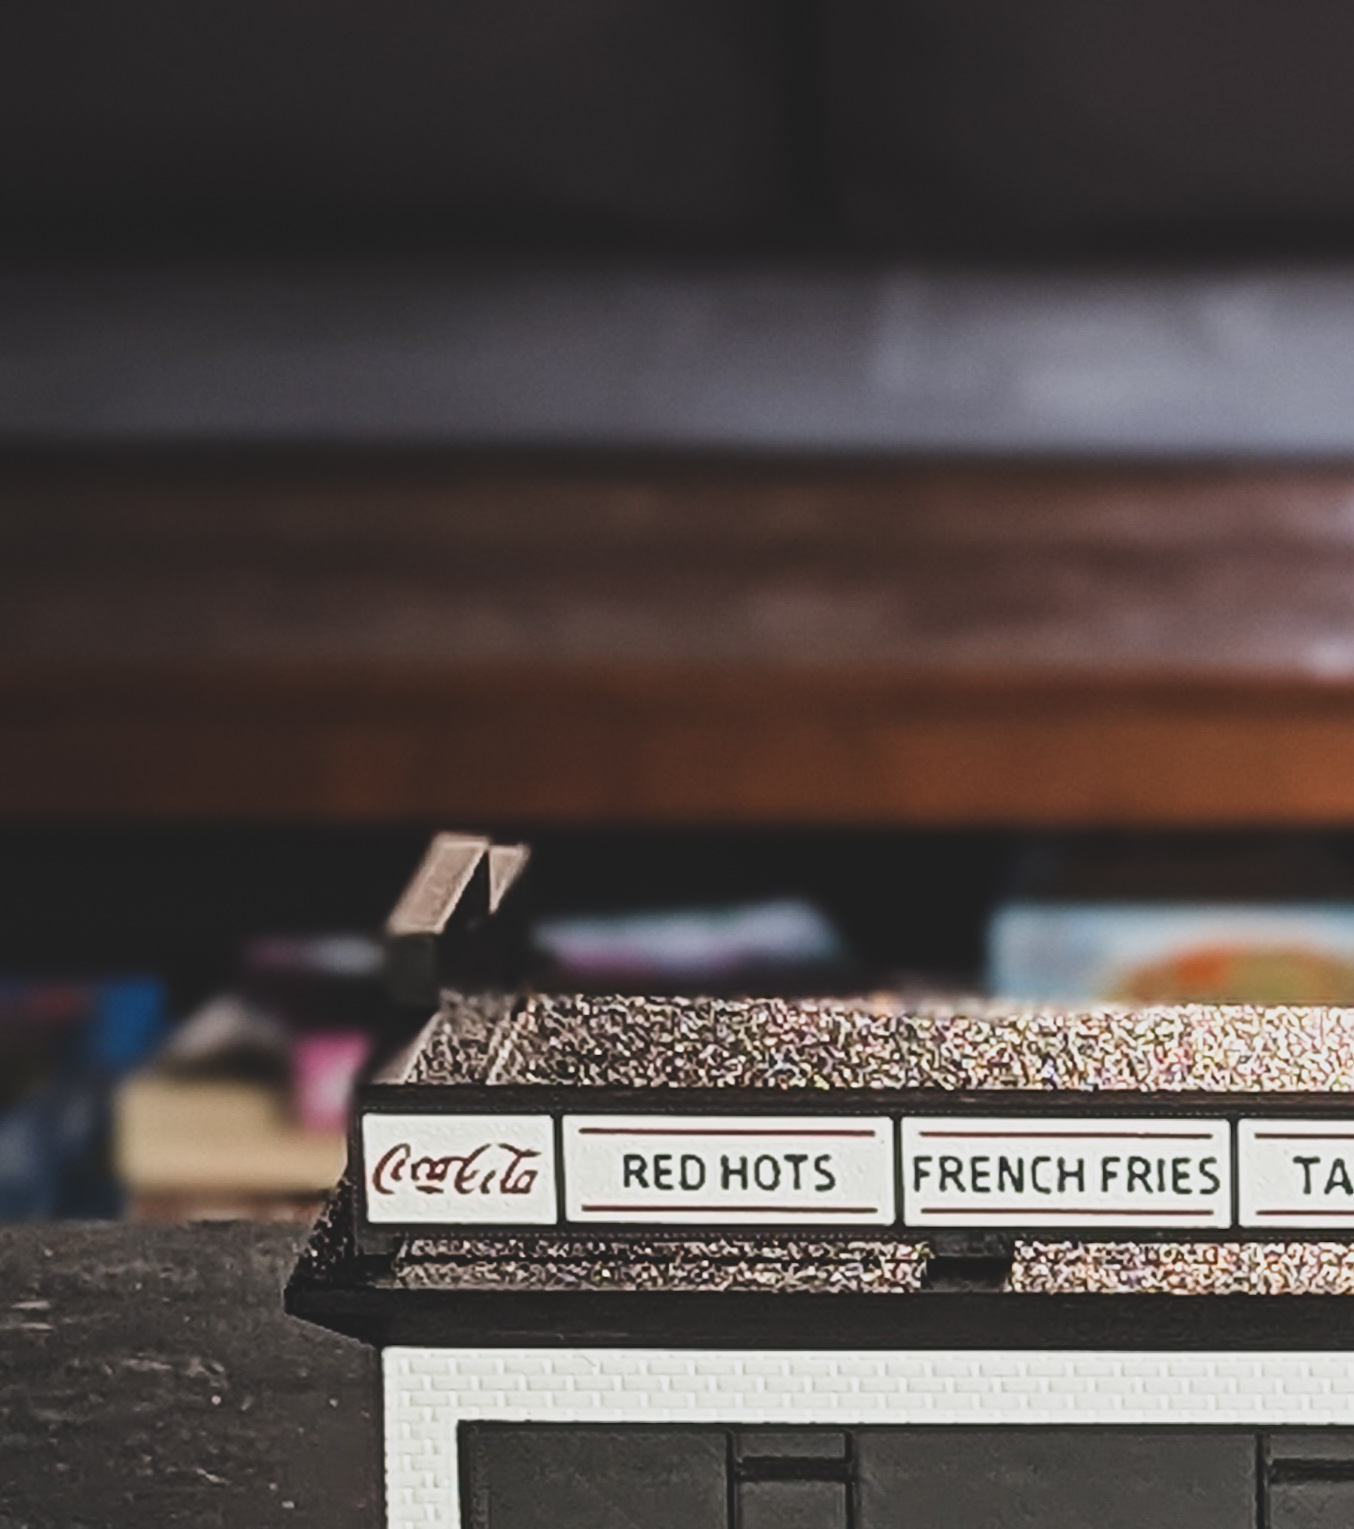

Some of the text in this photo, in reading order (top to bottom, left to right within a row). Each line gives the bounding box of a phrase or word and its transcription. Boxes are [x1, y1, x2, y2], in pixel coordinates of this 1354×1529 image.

[622, 1153, 837, 1192] RED HOTS
[912, 1155, 1221, 1195] FRENCH FRIES
